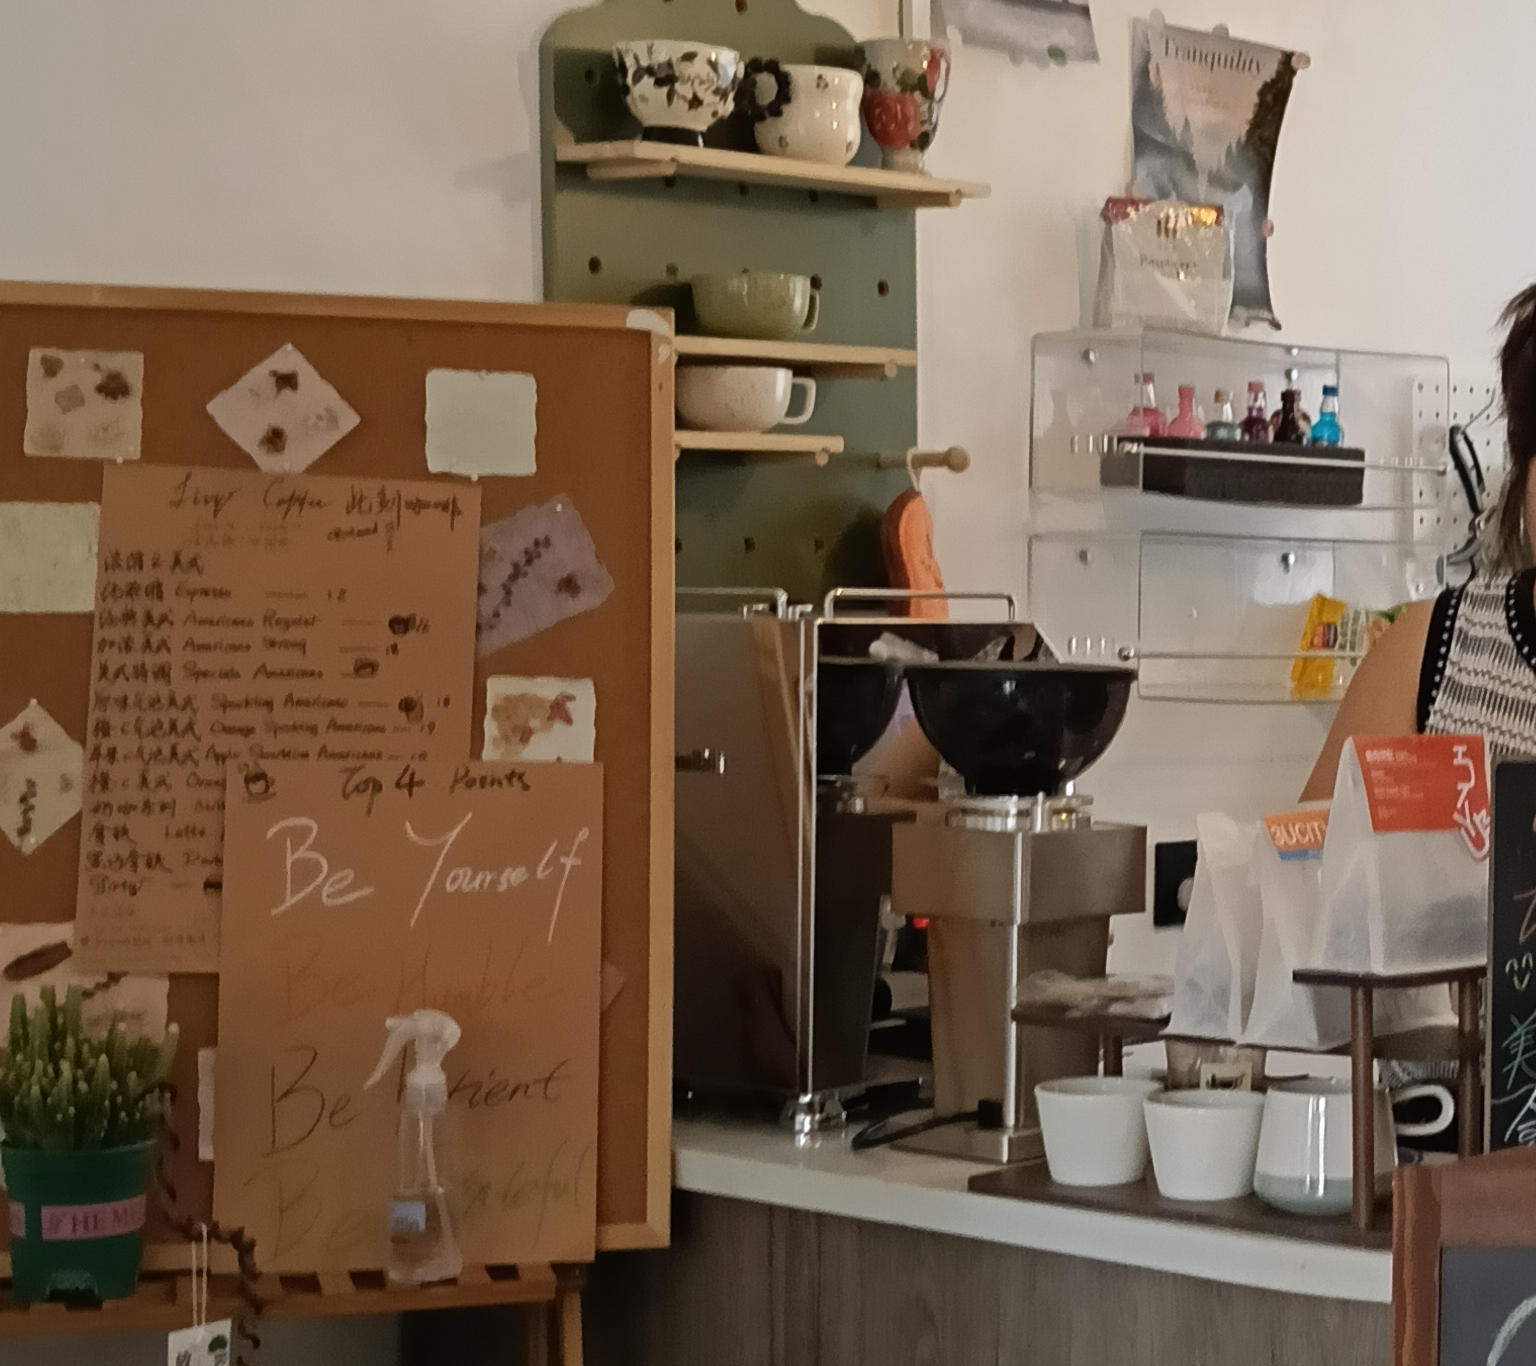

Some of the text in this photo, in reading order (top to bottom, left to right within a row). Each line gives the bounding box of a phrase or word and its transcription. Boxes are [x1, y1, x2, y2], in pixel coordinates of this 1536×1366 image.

[1162, 36, 1262, 78] Tranquility
[340, 765, 384, 816] Top
[395, 764, 426, 798] 4
[266, 811, 590, 945] Be Yourself
[262, 1043, 361, 1158] Be
